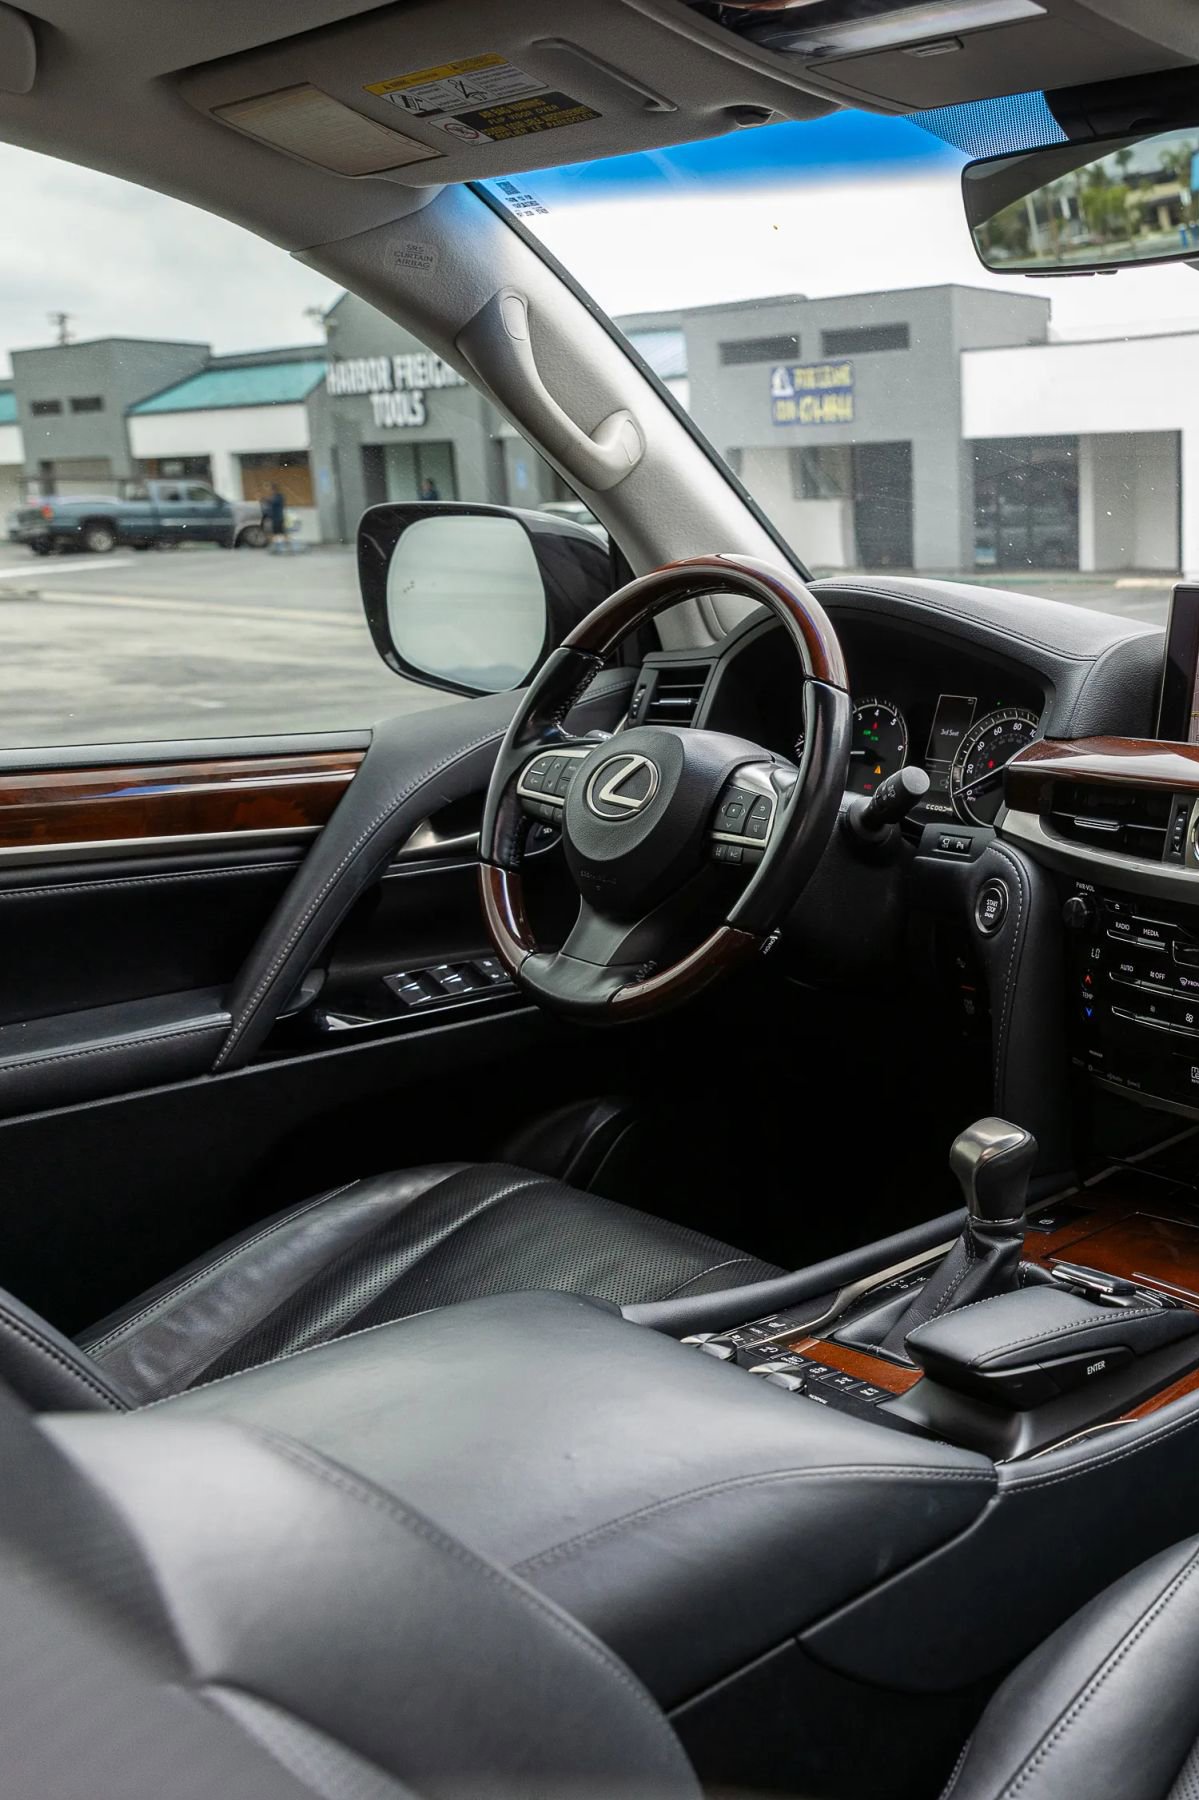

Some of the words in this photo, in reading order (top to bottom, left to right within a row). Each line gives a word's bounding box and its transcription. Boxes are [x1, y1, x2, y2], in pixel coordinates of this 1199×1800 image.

[535, 104, 560, 114] OVER
[394, 251, 433, 262] CURTAIN
[395, 258, 430, 268] AIRBAG
[392, 351, 467, 391] FREIG
[369, 389, 426, 428] TOOLS
[874, 709, 880, 717] 4
[993, 726, 1003, 736] 60
[1012, 722, 1023, 731] 80
[977, 741, 985, 751] 40
[966, 763, 974, 774] 20
[1115, 921, 1131, 931] RADIO
[1143, 928, 1160, 938] MEDIA
[1120, 963, 1134, 972] AUTO
[1155, 972, 1166, 981] OFF
[1086, 1360, 1106, 1375] ENTER
